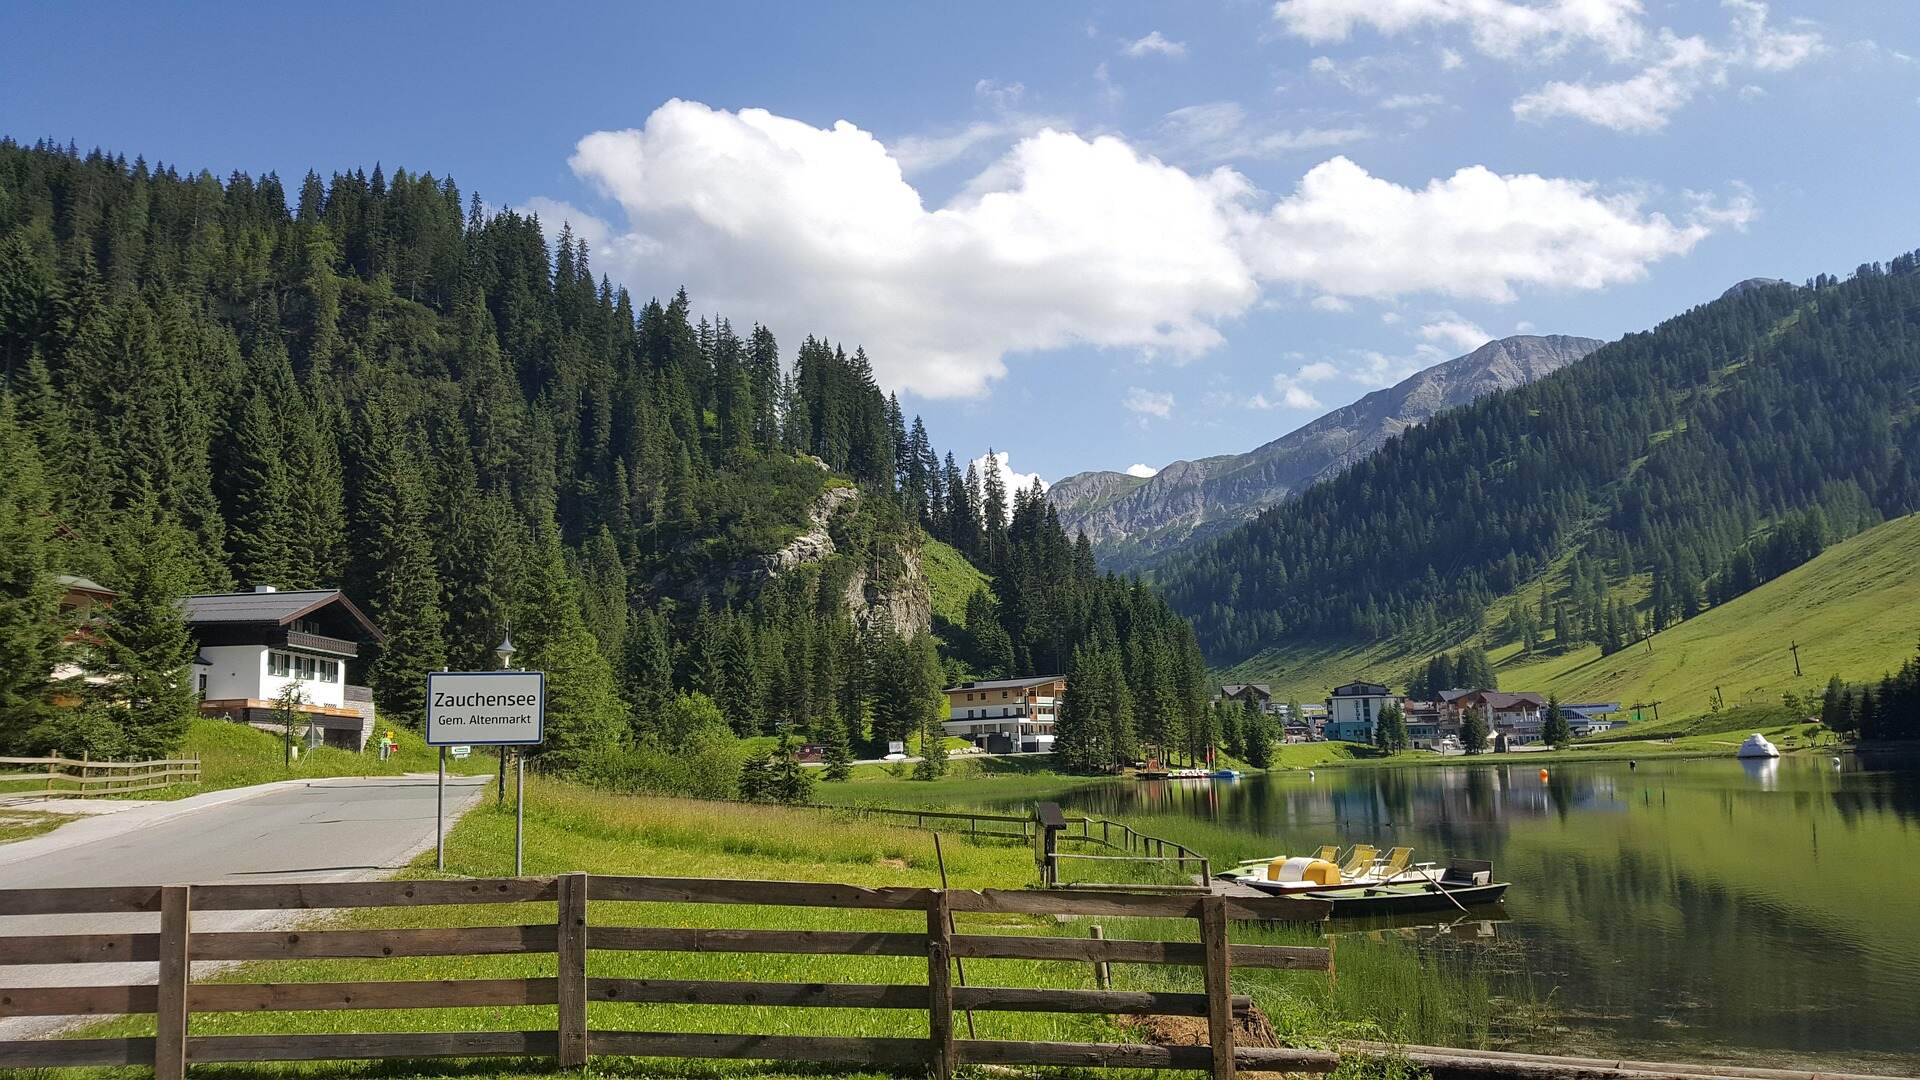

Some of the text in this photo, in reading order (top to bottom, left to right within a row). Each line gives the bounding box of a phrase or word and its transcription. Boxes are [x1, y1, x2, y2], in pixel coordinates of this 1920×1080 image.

[434, 692, 536, 707] Zauchensee
[438, 714, 531, 725] Gem. Altenmarkt
